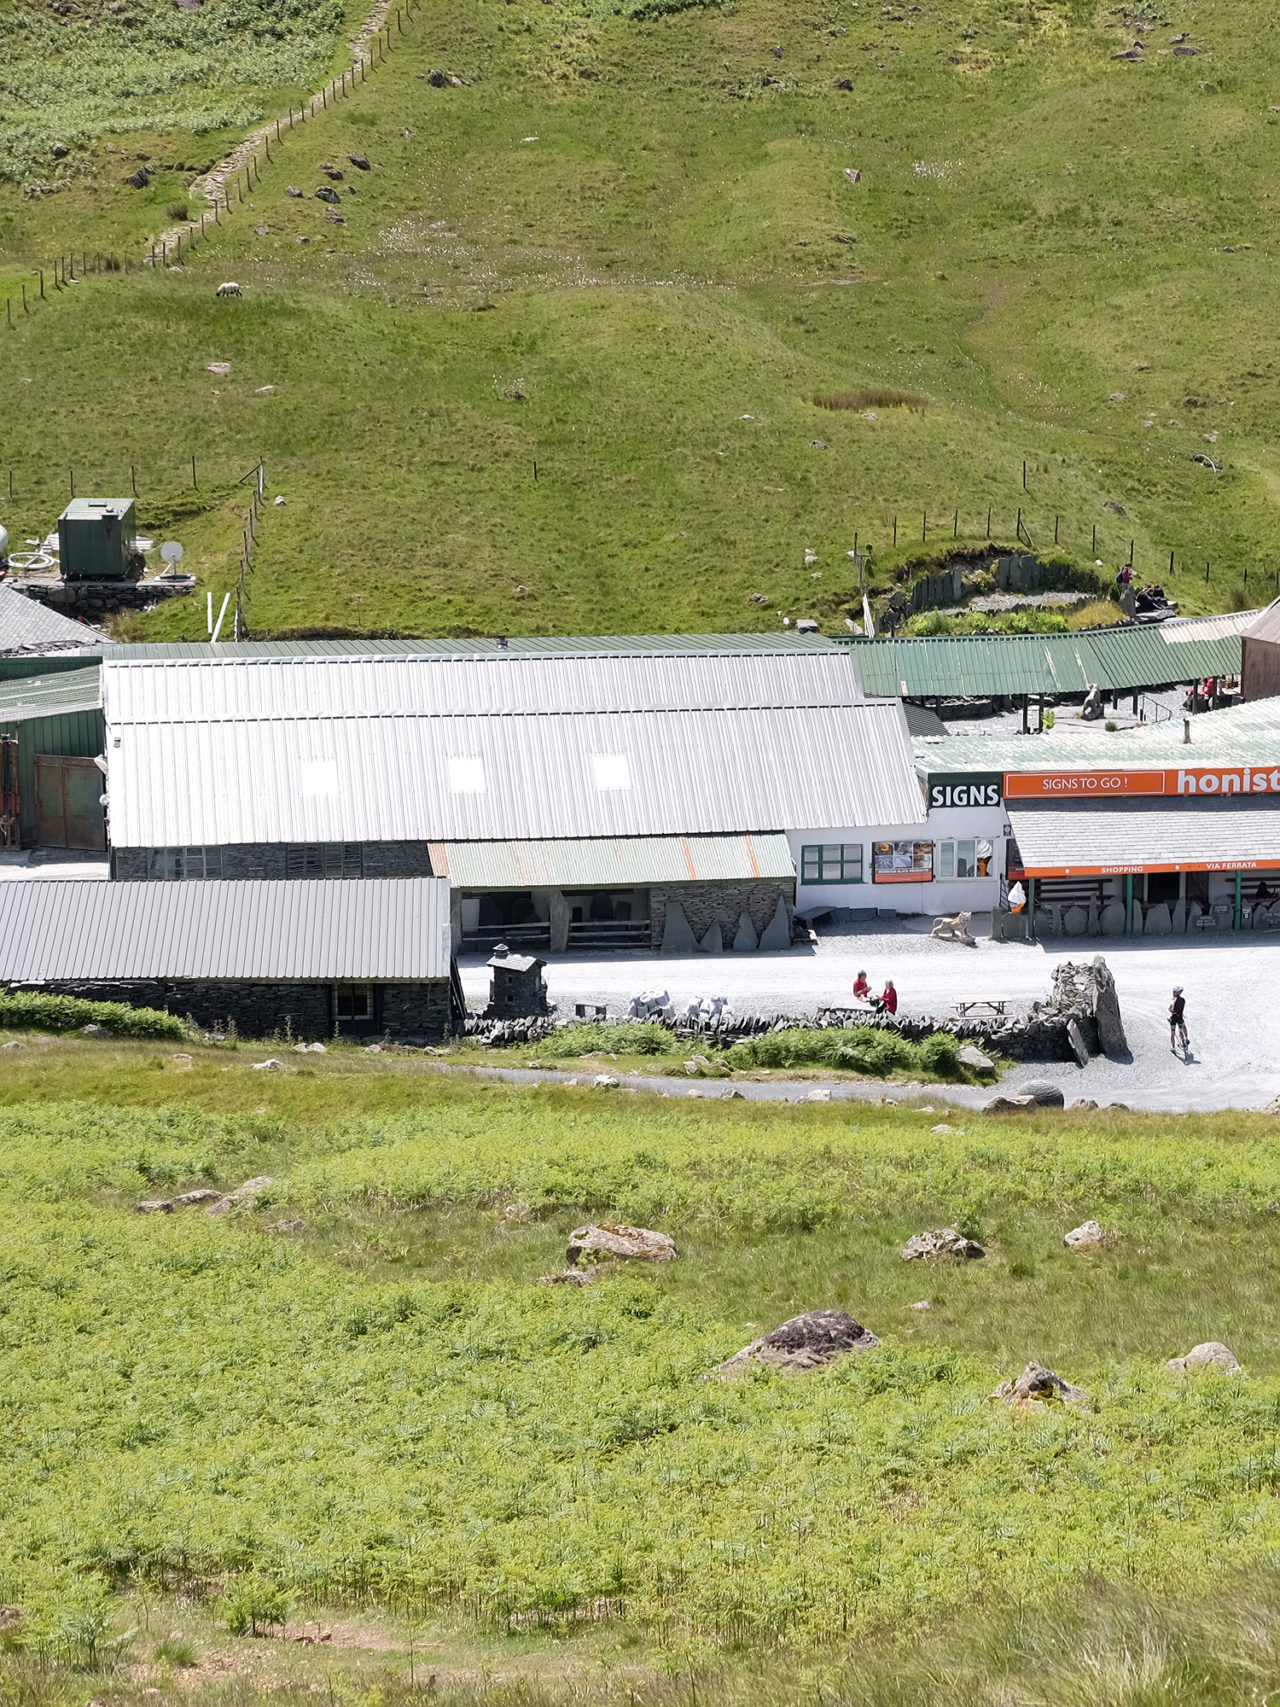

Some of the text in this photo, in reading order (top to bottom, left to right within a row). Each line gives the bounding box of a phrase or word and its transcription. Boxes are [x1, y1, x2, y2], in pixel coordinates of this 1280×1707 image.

[1043, 778, 1078, 790] SIGNS
[1080, 778, 1097, 789] TO
[1101, 778, 1120, 788] GO
[931, 785, 999, 807] SIGNS
[1101, 865, 1144, 874] SHOPPING
[1223, 861, 1257, 869] FERRATA
